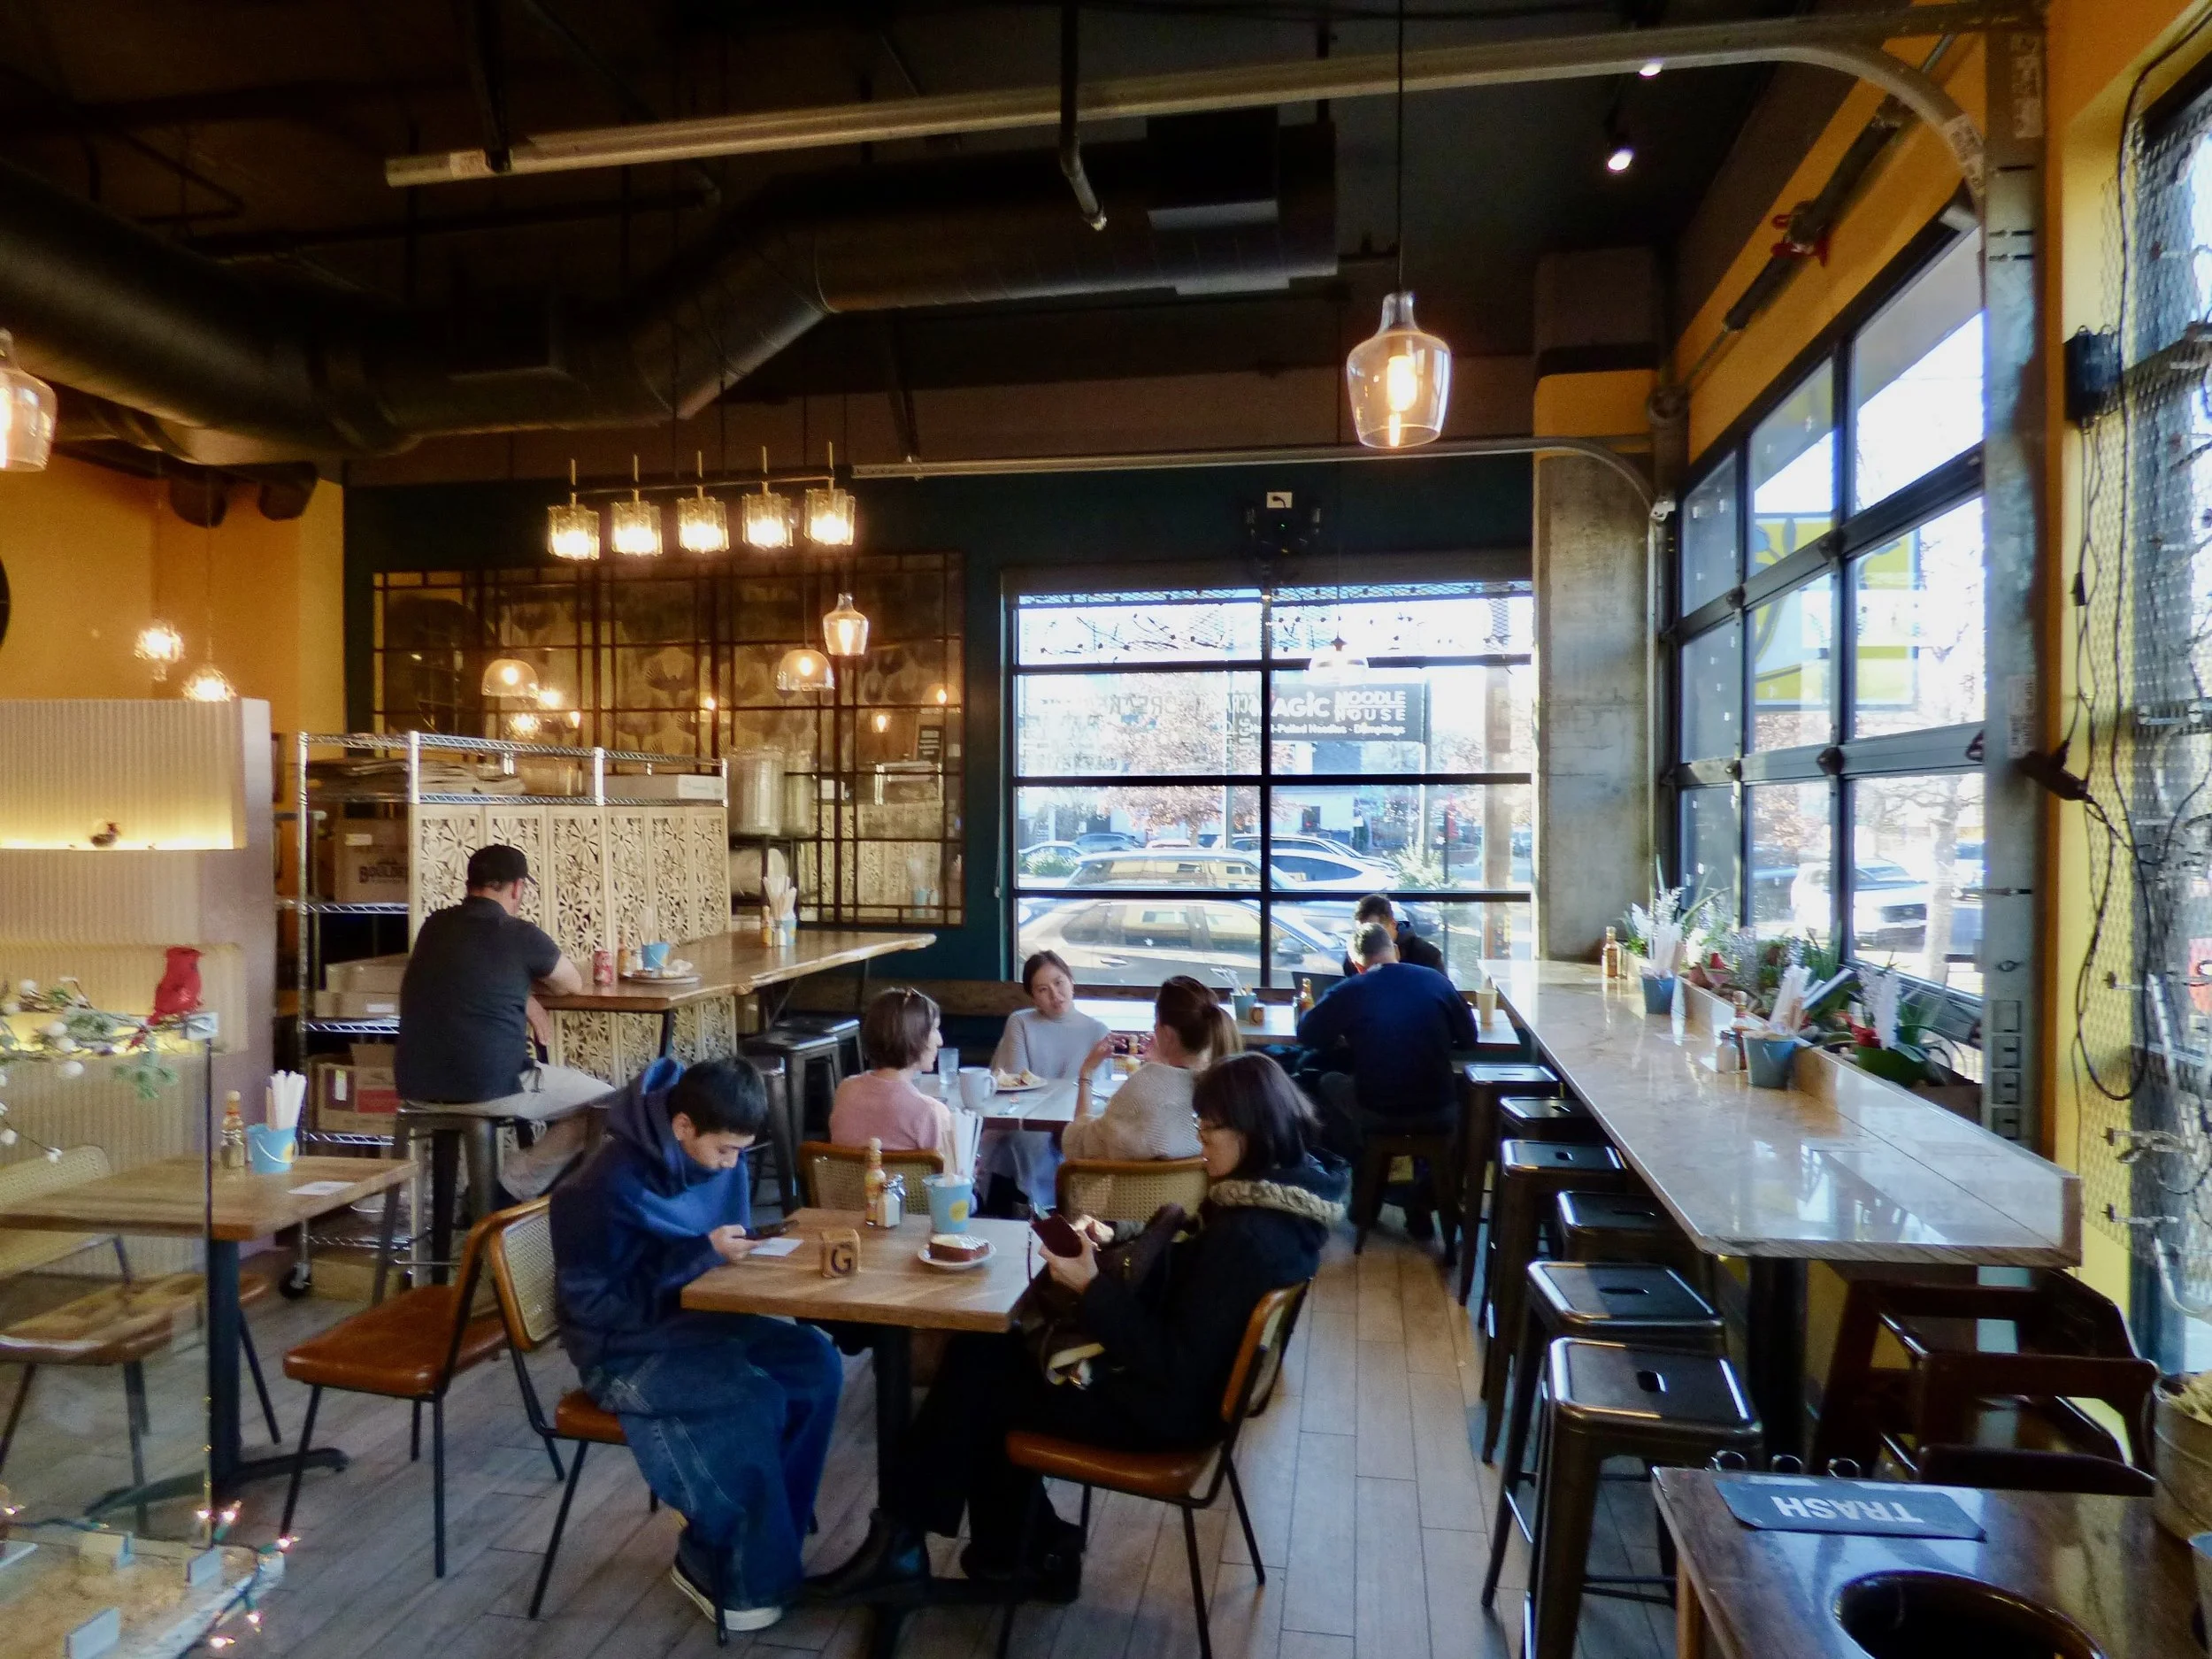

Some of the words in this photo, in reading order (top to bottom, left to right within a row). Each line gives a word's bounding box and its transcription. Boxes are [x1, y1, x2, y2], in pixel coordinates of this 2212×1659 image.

[1334, 690, 1407, 705] NOODLE
[831, 1242, 852, 1274] G
[1770, 1495, 1925, 1525] TRASH
